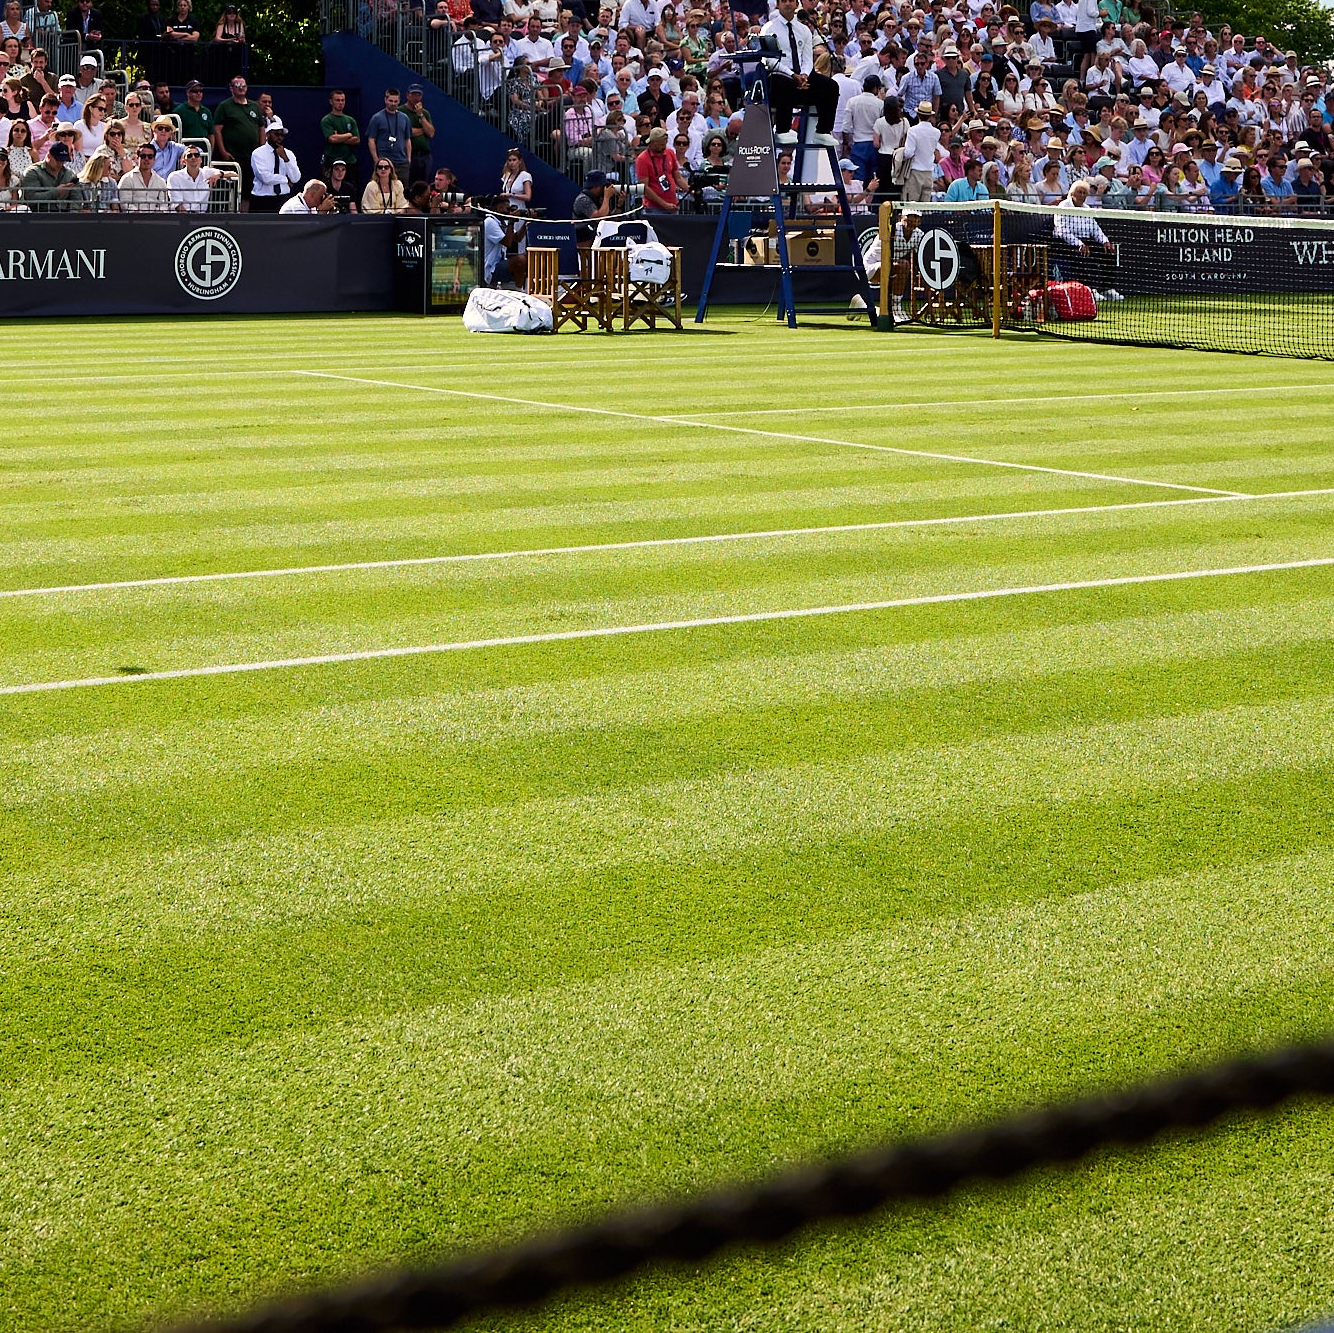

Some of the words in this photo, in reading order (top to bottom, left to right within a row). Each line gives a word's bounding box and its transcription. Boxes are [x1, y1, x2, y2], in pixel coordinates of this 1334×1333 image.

[1157, 228, 1209, 243] HILTON
[1214, 228, 1254, 243] HEAD
[1179, 247, 1233, 263] ISLAND
